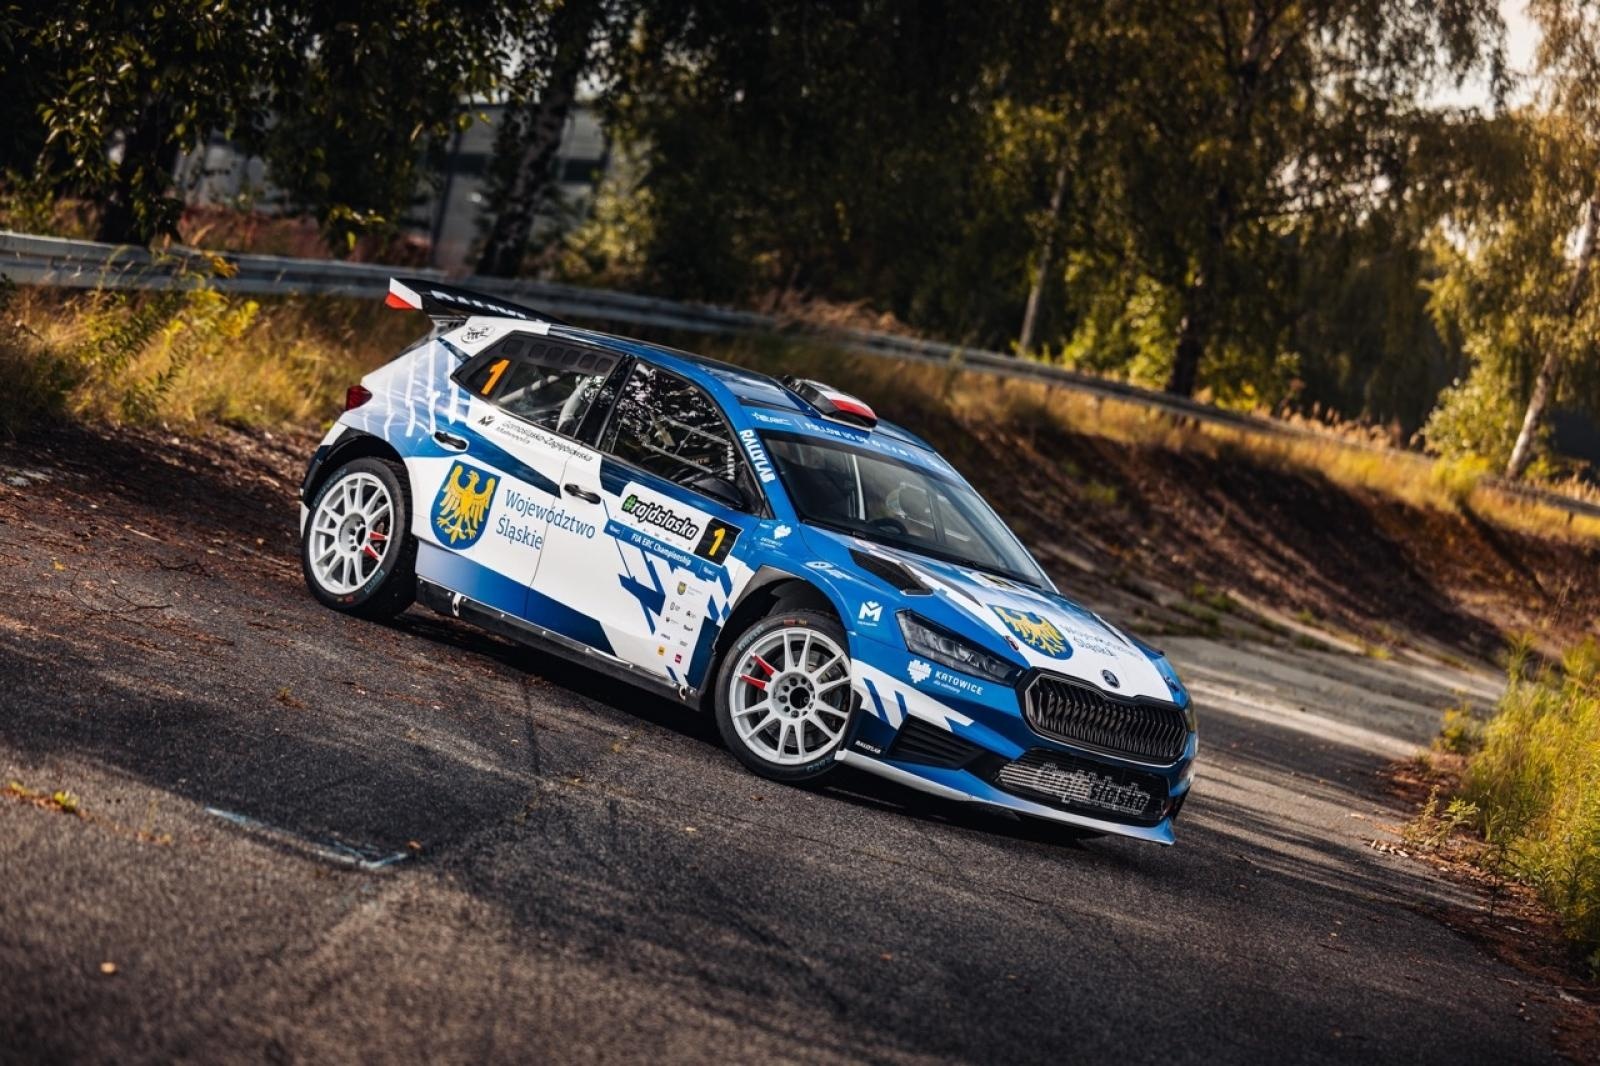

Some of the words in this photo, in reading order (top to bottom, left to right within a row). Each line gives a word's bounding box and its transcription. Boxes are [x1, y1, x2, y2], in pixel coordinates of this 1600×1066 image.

[480, 359, 511, 396] 1
[739, 429, 776, 483] RALLYLAB
[495, 514, 544, 550] Śląskie
[505, 489, 596, 540] Województwo
[630, 532, 641, 544] FIA
[653, 541, 692, 566] Championship
[708, 527, 727, 557] 1
[934, 670, 984, 696] KATOWICE
